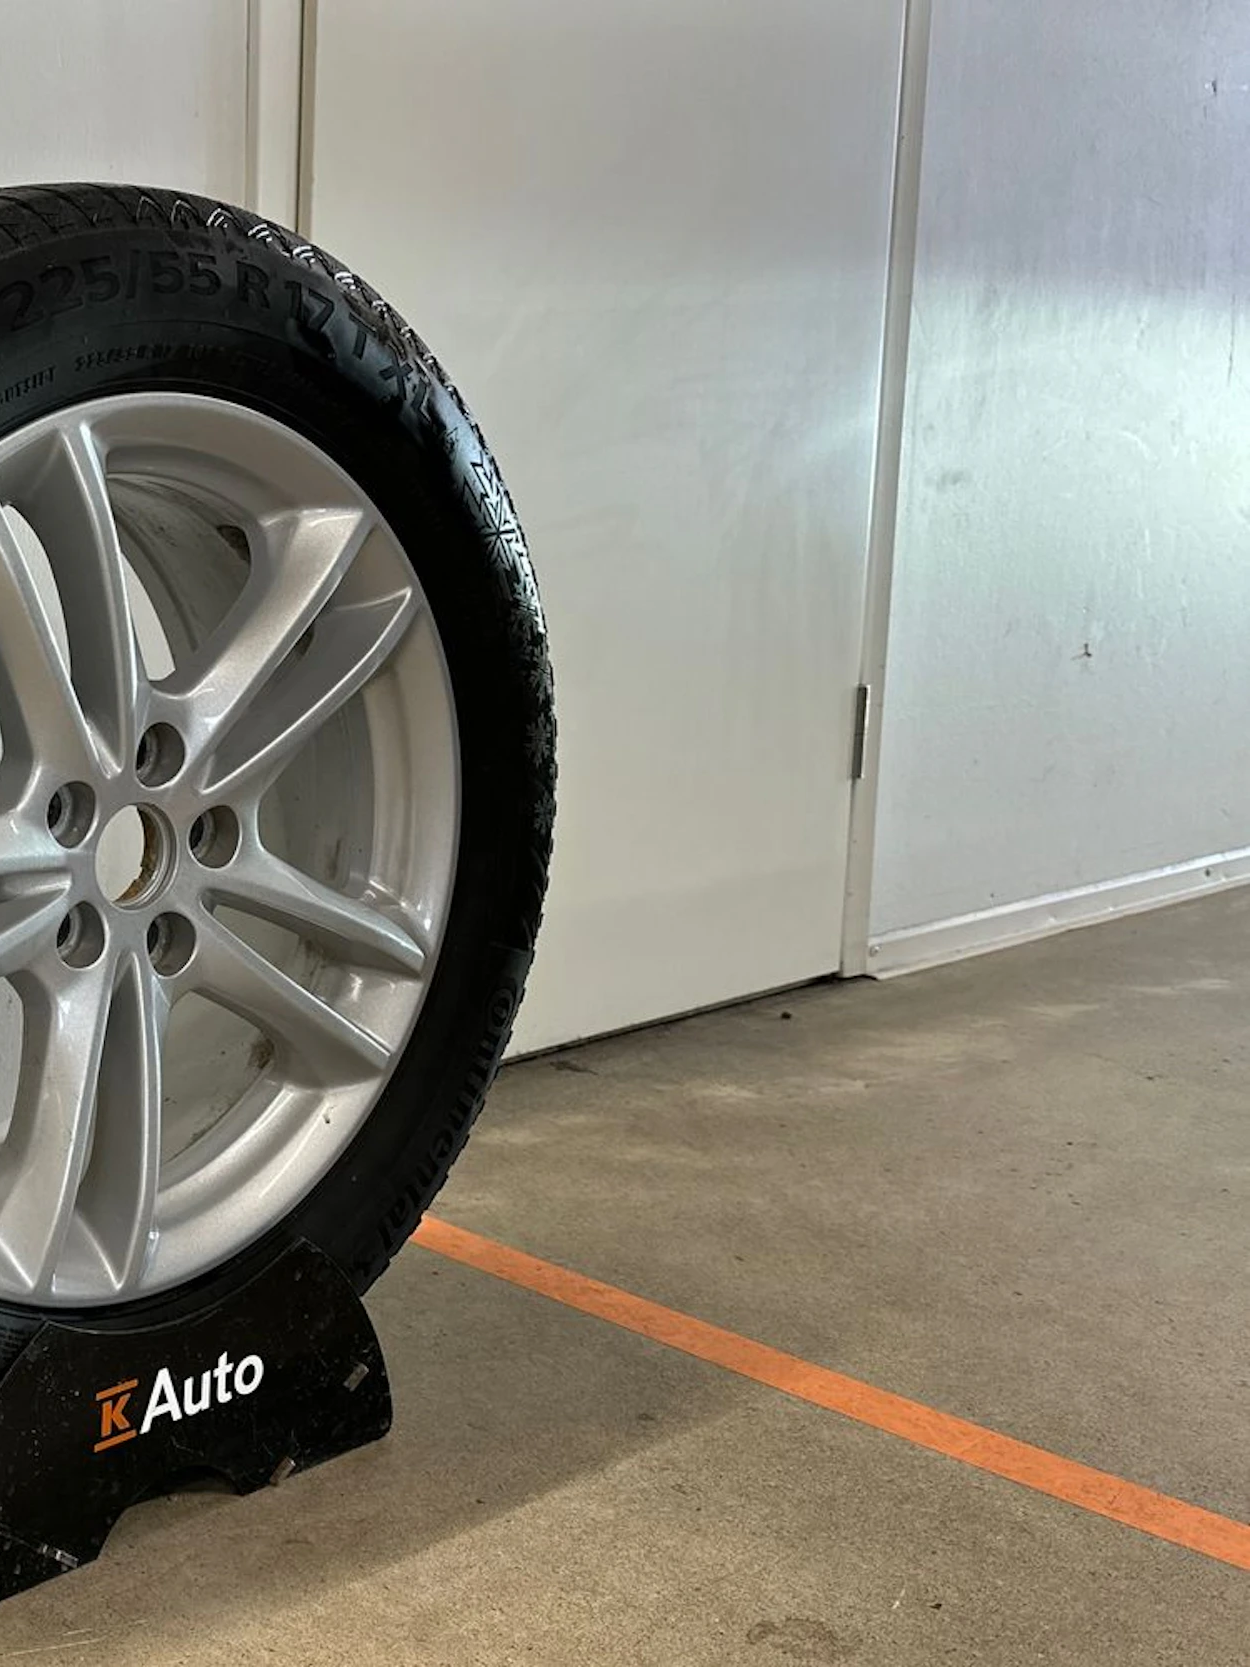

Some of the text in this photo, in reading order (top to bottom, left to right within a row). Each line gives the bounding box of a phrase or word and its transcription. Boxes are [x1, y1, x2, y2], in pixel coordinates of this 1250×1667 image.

[235, 262, 272, 309] R
[284, 280, 338, 335] 17
[350, 316, 377, 361] T
[139, 1351, 265, 1435] Auto
